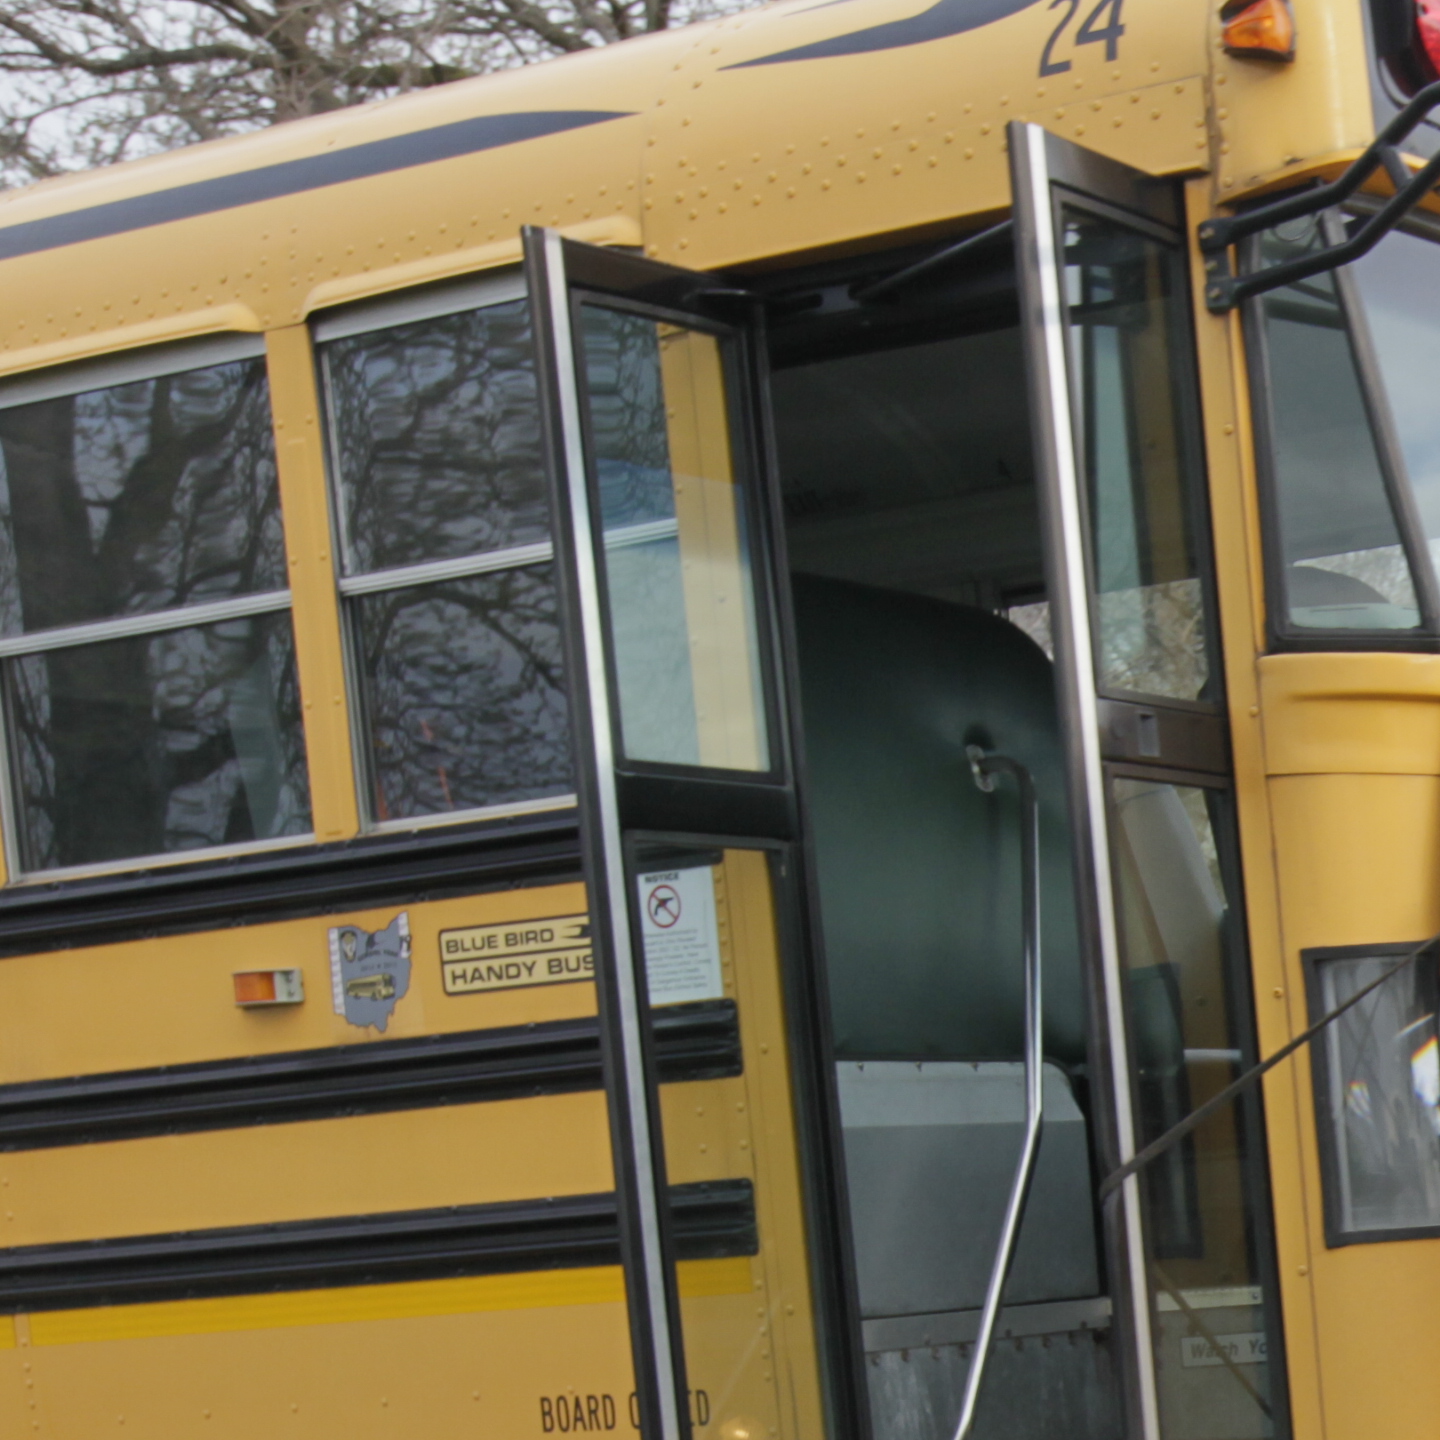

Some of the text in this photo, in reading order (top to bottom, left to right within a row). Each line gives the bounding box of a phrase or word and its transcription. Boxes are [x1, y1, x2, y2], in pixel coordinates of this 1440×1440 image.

[1038, 0, 1126, 79] 24
[445, 927, 555, 954] BLUE BIRD
[451, 954, 595, 986] HANDY BUS
[1190, 1341, 1240, 1359] Wah
[540, 1393, 617, 1433] BOARD
